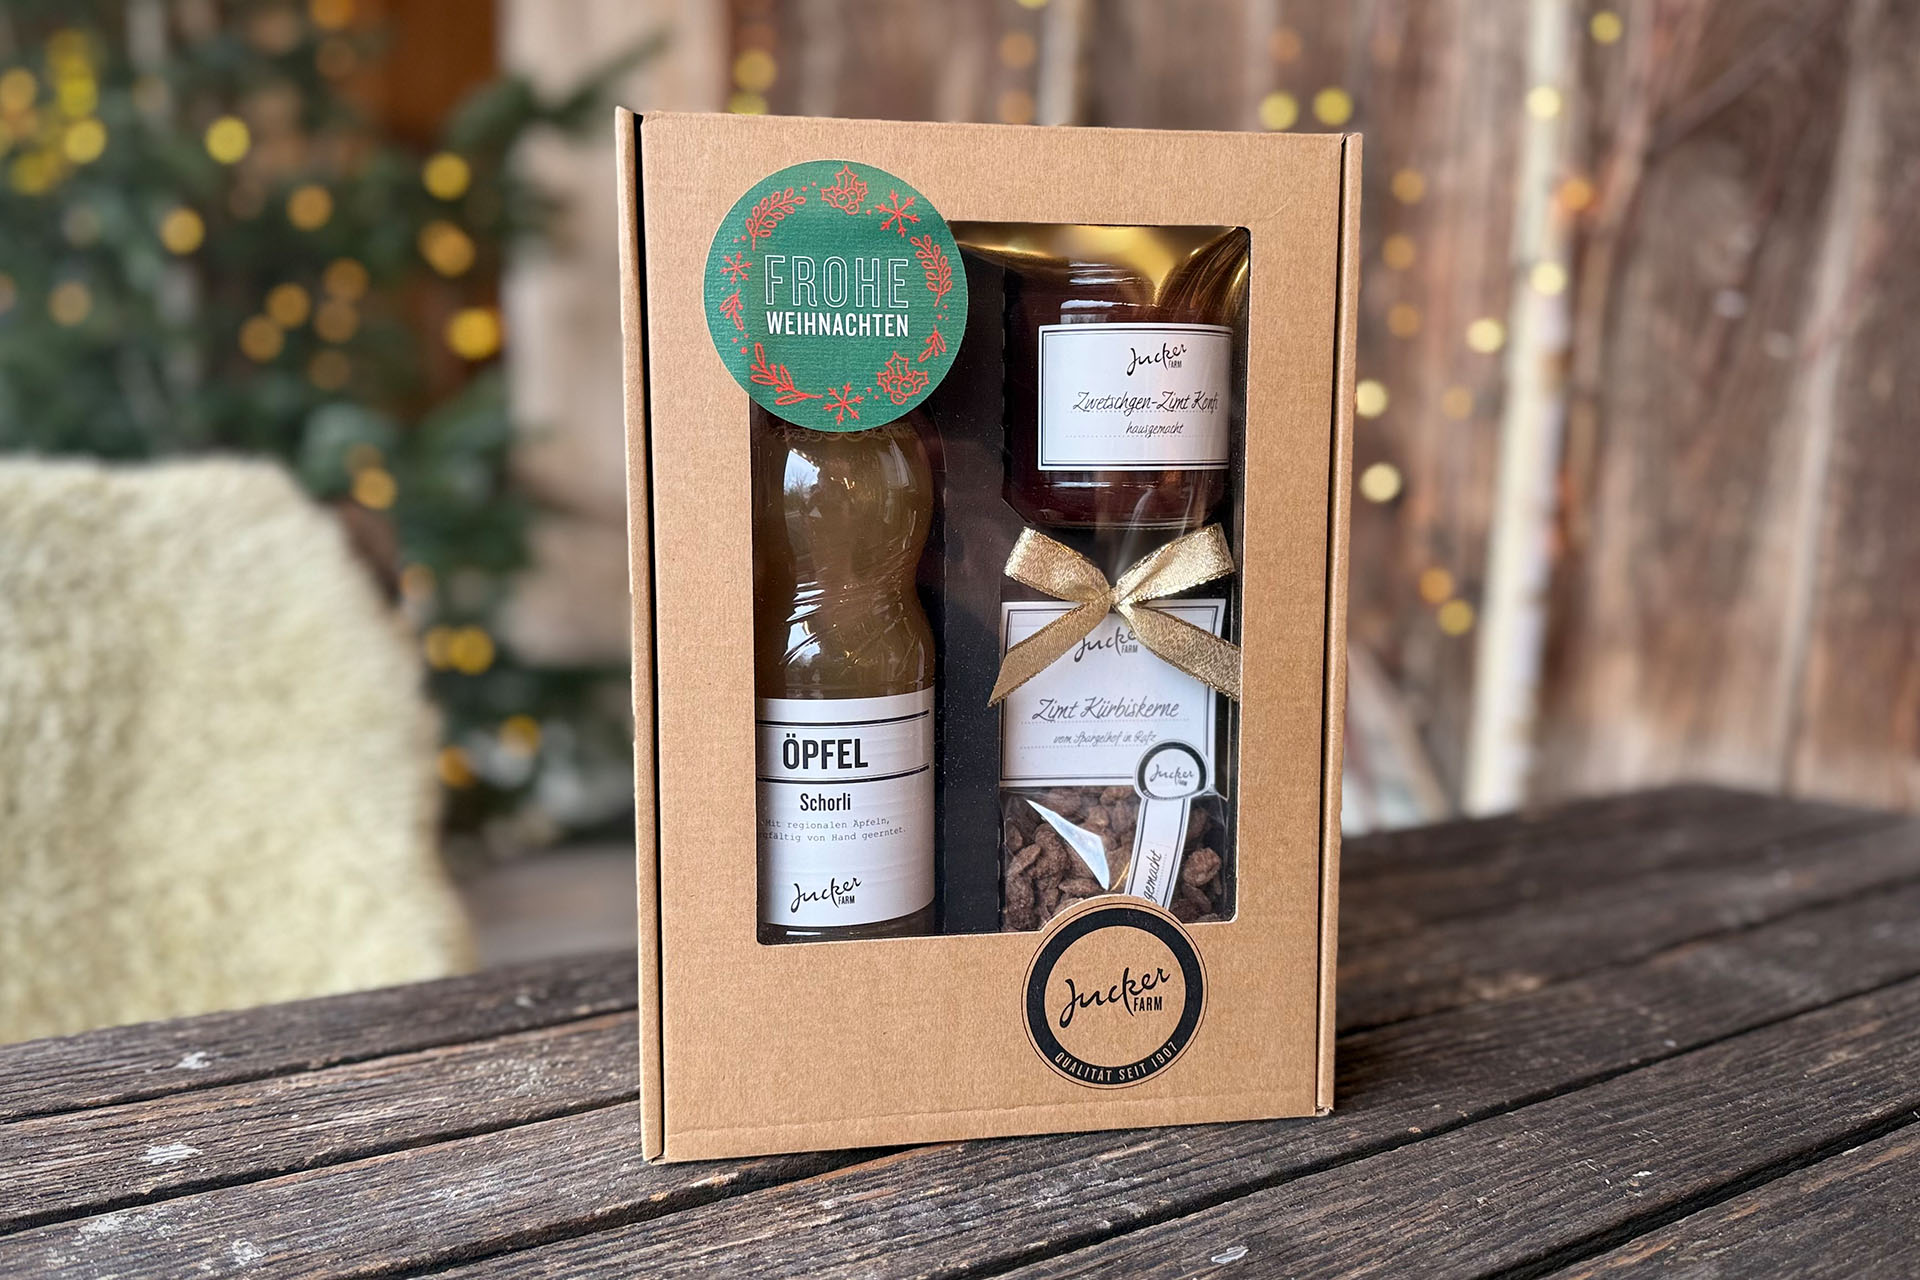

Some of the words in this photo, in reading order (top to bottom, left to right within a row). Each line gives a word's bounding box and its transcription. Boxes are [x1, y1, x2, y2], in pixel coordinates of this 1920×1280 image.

[765, 255, 909, 309] FROHE
[766, 311, 909, 337] WEIHNACHTEN
[1126, 342, 1187, 376] Jucker
[1073, 391, 1190, 417] Zwetschgen-Zimt
[1126, 421, 1184, 438] hausgemacht
[1074, 627, 1136, 662] Jucke
[1121, 645, 1138, 653] FARM
[1032, 699, 1078, 723] Zimt
[1080, 696, 1180, 719] Kürbiskerne
[782, 733, 869, 770] ÖPFEL
[1053, 735, 1072, 744] vom
[1123, 733, 1132, 742] in
[1150, 764, 1194, 785] Jucker
[800, 792, 851, 811] Schorli
[760, 830, 801, 842] gfältig
[831, 832, 857, 842] Hand
[787, 820, 848, 830] regionalen
[790, 877, 862, 913] Jucker
[838, 895, 855, 905] FARM
[1059, 967, 1171, 1028] Jucker
[1133, 996, 1162, 1012] FARM
[1054, 1051, 1113, 1082] QUALITÄT
[1118, 1063, 1147, 1081] SEIT
[1151, 1041, 1178, 1068] 1907
